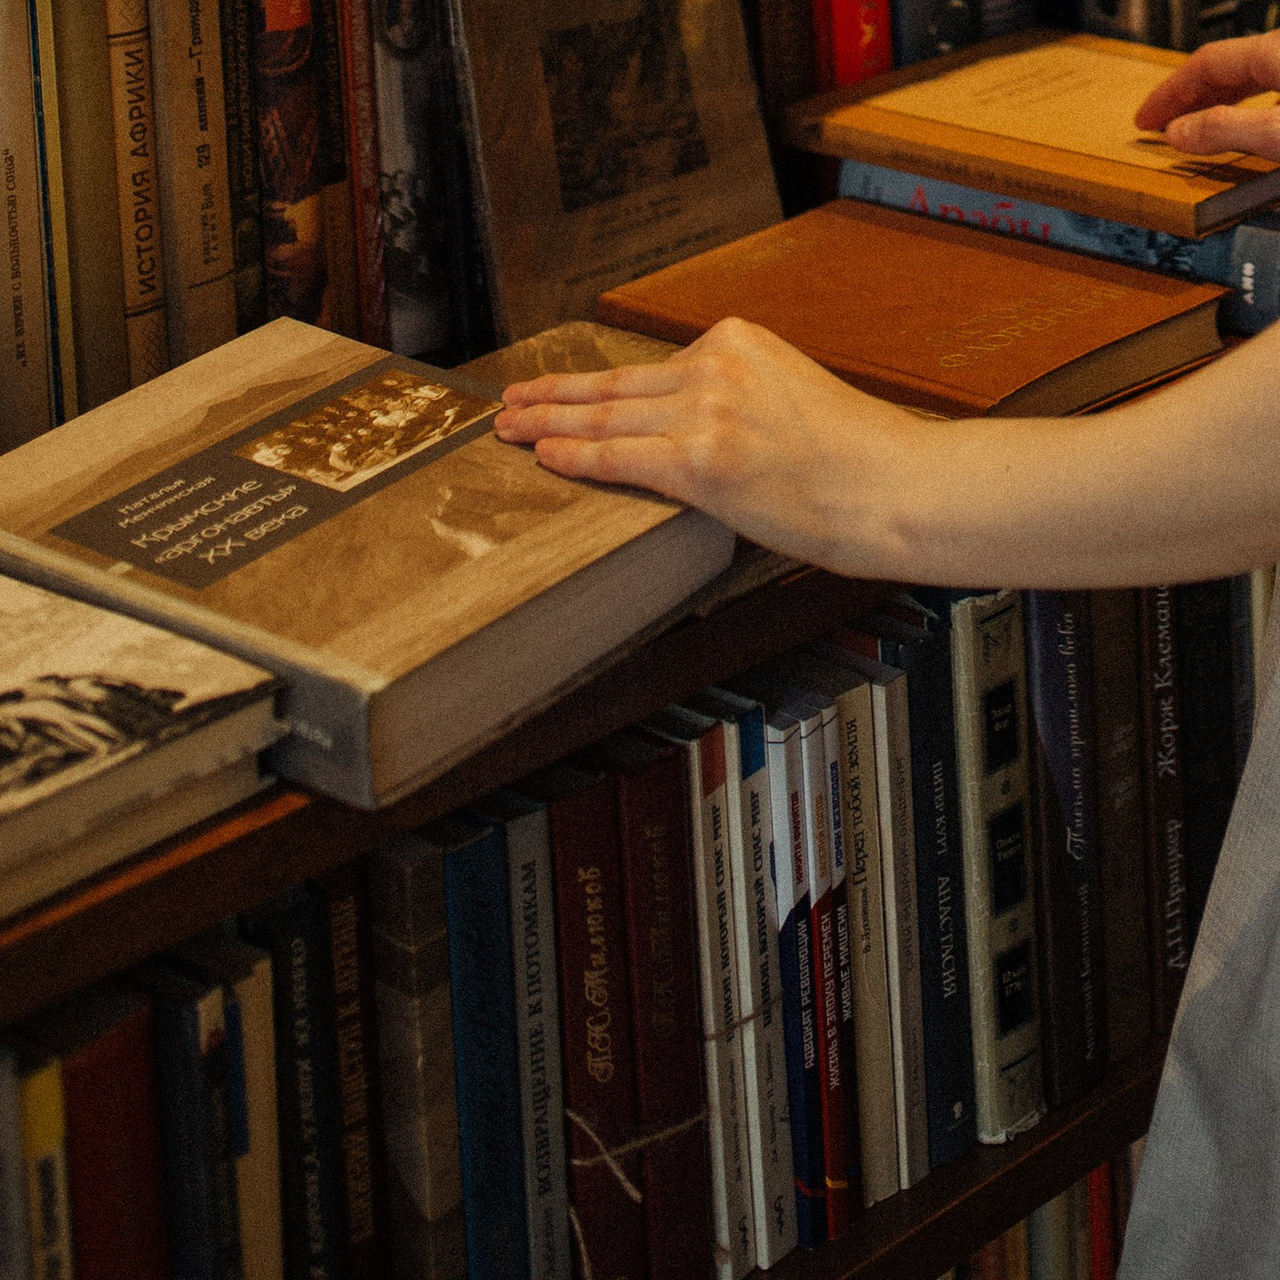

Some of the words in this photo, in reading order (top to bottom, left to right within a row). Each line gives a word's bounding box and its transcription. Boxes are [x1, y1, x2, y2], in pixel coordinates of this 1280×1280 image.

[124, 47, 149, 158] АФРИКИ
[237, 12, 252, 141] ИМПЕРАТОРСКОГО
[196, 143, 212, 170] 129
[240, 142, 253, 188] ЛЮДИ
[6, 194, 22, 280] вольностью
[130, 169, 157, 296] ИСТОРИЯ
[117, 478, 188, 515] Наталья
[130, 478, 264, 550] Крымские
[153, 483, 299, 565] аргонавты
[198, 536, 247, 565] XX
[243, 503, 310, 542] века
[1057, 611, 1078, 657] века
[1062, 661, 1085, 760] прошлого
[1156, 695, 1180, 777] Жорж
[844, 718, 860, 770] земля
[749, 789, 762, 827] МИР
[814, 793, 826, 828] ПОПОВ
[846, 776, 865, 826] тобой
[932, 760, 948, 812] ПИТЕР
[1063, 765, 1088, 862] Письма
[710, 804, 724, 842] МИР
[791, 790, 803, 842] ФИЛАТОВ
[934, 815, 950, 856] КУРТ
[711, 845, 725, 887] СПАС
[751, 831, 764, 873] СПАС
[792, 843, 804, 885] НИКИТА
[816, 830, 827, 879] ВАЛЕРИЙ
[833, 830, 844, 868] РОМАН
[851, 830, 869, 886] Перед
[1162, 818, 1186, 919] Прицкер
[519, 860, 545, 996] ПОТОМКАМ
[576, 865, 611, 1007] Милюков
[714, 890, 731, 970] КОТОРЫЙ
[753, 877, 769, 953] КОТОРЫЙ
[835, 903, 850, 965] МИШЕНИ
[938, 874, 960, 1000] АНАСТАСИЯ
[796, 918, 812, 1005] РЕВОЛЮЦИИ
[820, 912, 835, 976] ПЕРЕМЕН
[526, 1001, 544, 1018] К
[824, 979, 838, 1025] ЭПОХУ
[838, 968, 853, 1022] ЖИВЫЕ
[800, 1007, 815, 1070] АДВОКАТ
[828, 1040, 841, 1090] ЖИЗНЬ
[529, 1023, 554, 1197] ВОЗВРАЩЕНИЕ
